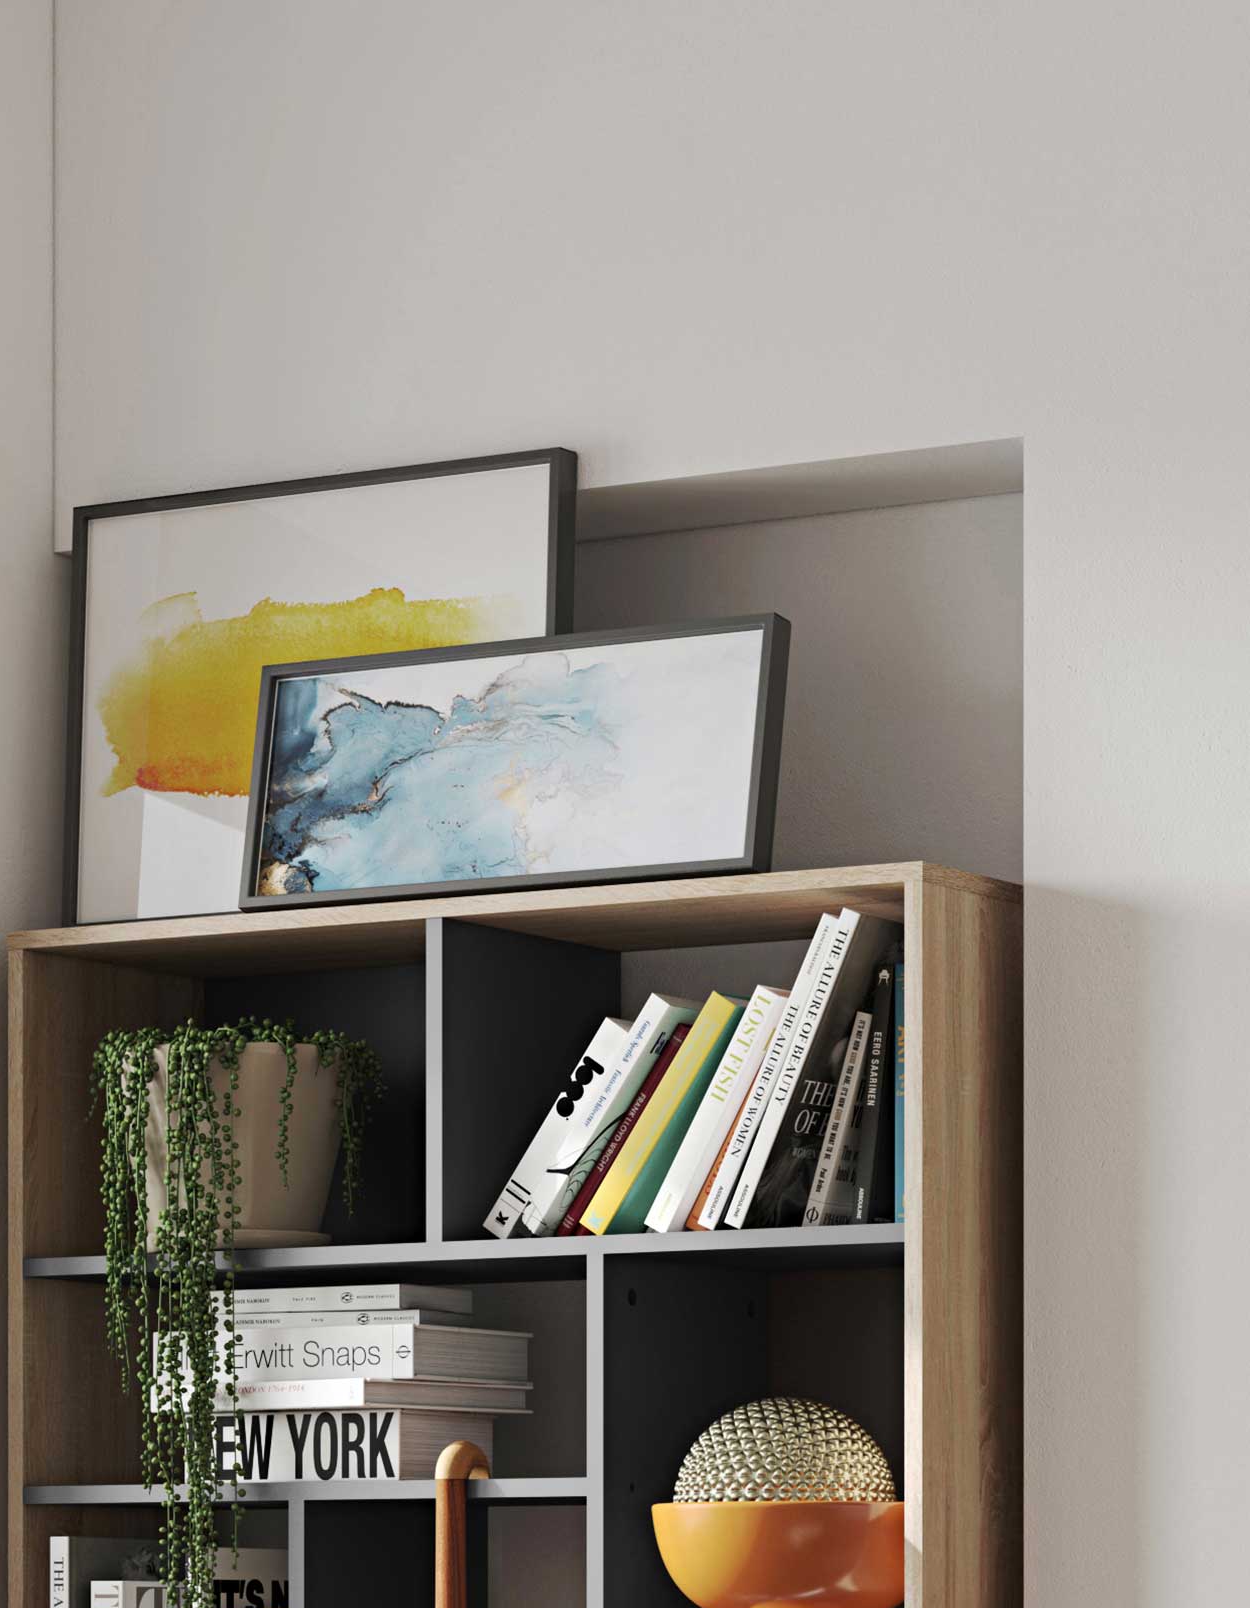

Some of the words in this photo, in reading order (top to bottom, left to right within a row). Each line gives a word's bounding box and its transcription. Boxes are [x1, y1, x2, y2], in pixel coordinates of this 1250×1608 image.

[829, 929, 849, 960] THE
[806, 961, 835, 1020] ALLURE
[737, 995, 771, 1053] LOST
[782, 1004, 799, 1032] THE
[798, 1022, 812, 1044] OF
[760, 1033, 786, 1084] ALLURE
[871, 1031, 882, 1056] EERO
[711, 1053, 744, 1102] FISH
[775, 1044, 805, 1106] BEAUTY
[866, 1058, 880, 1106] SAARINEN
[629, 1092, 647, 1118] FRANK
[753, 1086, 765, 1105] OF
[614, 1117, 633, 1142] LLOYD
[730, 1107, 758, 1157] WOMEN
[596, 1142, 618, 1172] WRIGHT
[707, 1185, 724, 1219] ASSOULINE
[733, 1184, 749, 1217] ASSOULINE
[234, 1342, 295, 1369] Erwitt
[302, 1340, 382, 1371] Snaps
[214, 1413, 275, 1480] EW
[286, 1411, 396, 1481] YORK
[53, 1557, 64, 1593] THE
